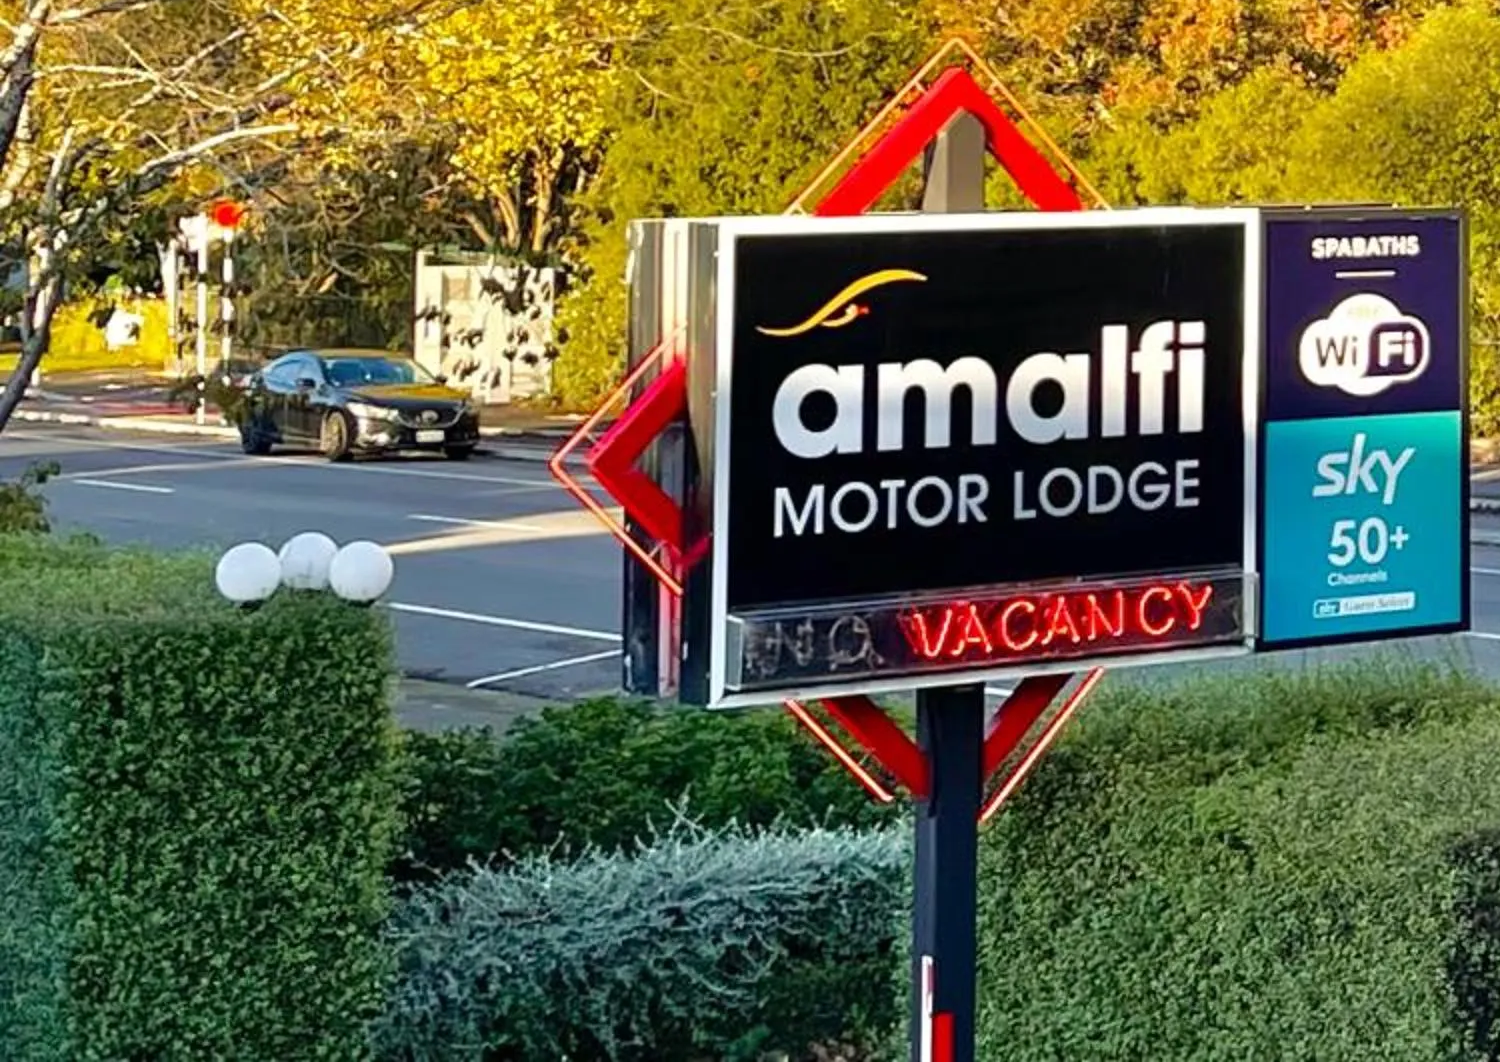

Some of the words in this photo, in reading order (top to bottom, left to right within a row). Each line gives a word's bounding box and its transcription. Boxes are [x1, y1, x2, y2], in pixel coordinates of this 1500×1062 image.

[1311, 235, 1421, 259] SPABATHS
[772, 321, 1206, 459] amalfi
[773, 474, 989, 538] MOTOR
[1013, 459, 1200, 520] LODGE
[1312, 433, 1417, 505] sky
[1327, 517, 1410, 567] 50+
[912, 581, 1212, 657] VACANCY
